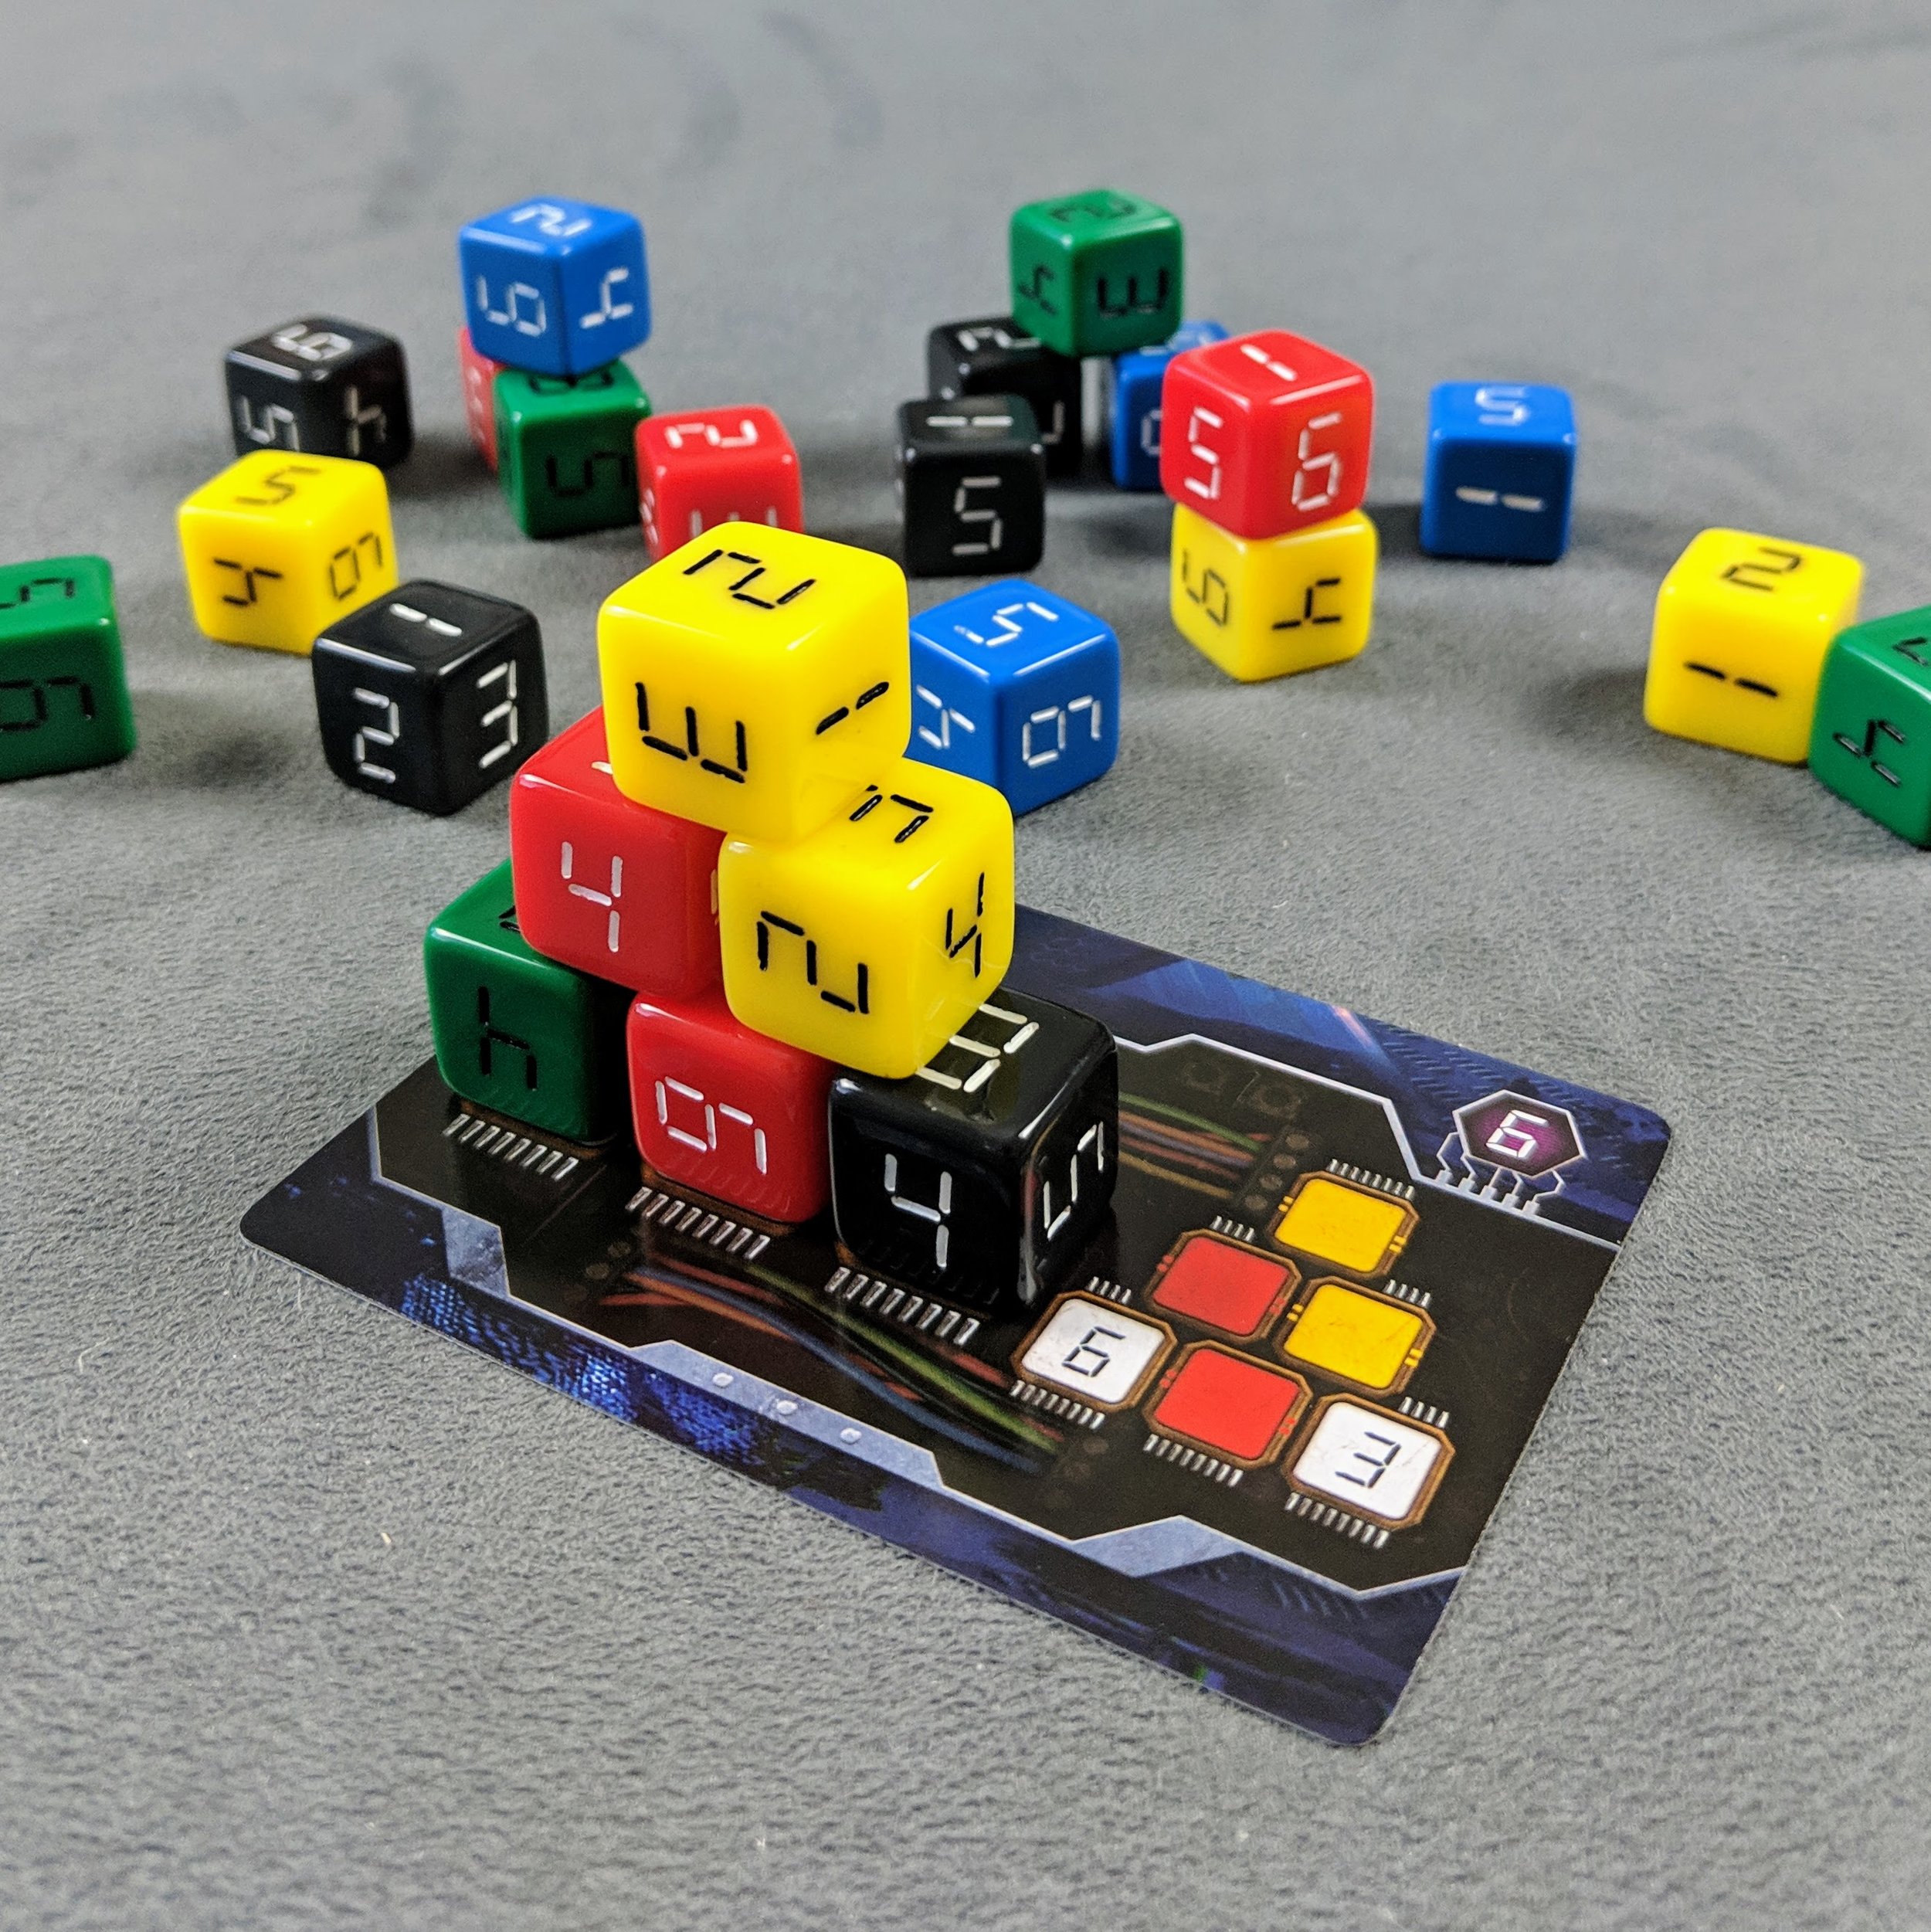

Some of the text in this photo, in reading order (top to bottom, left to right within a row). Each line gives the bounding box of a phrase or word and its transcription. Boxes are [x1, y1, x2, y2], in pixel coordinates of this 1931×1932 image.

[1183, 406, 1223, 501] 5
[1474, 386, 1528, 426] 5
[235, 465, 323, 506] 5
[1291, 410, 1342, 511] 6
[952, 476, 1001, 555] 5
[1721, 545, 1802, 593] 2
[352, 686, 400, 784] 2
[476, 659, 519, 769] 3
[635, 681, 747, 783] 3
[562, 840, 623, 952] 4
[945, 871, 986, 979] 4
[1485, 1109, 1550, 1160] 6
[884, 1152, 953, 1269] 4
[1061, 1325, 1126, 1378] 6
[1334, 1430, 1402, 1489] 3
